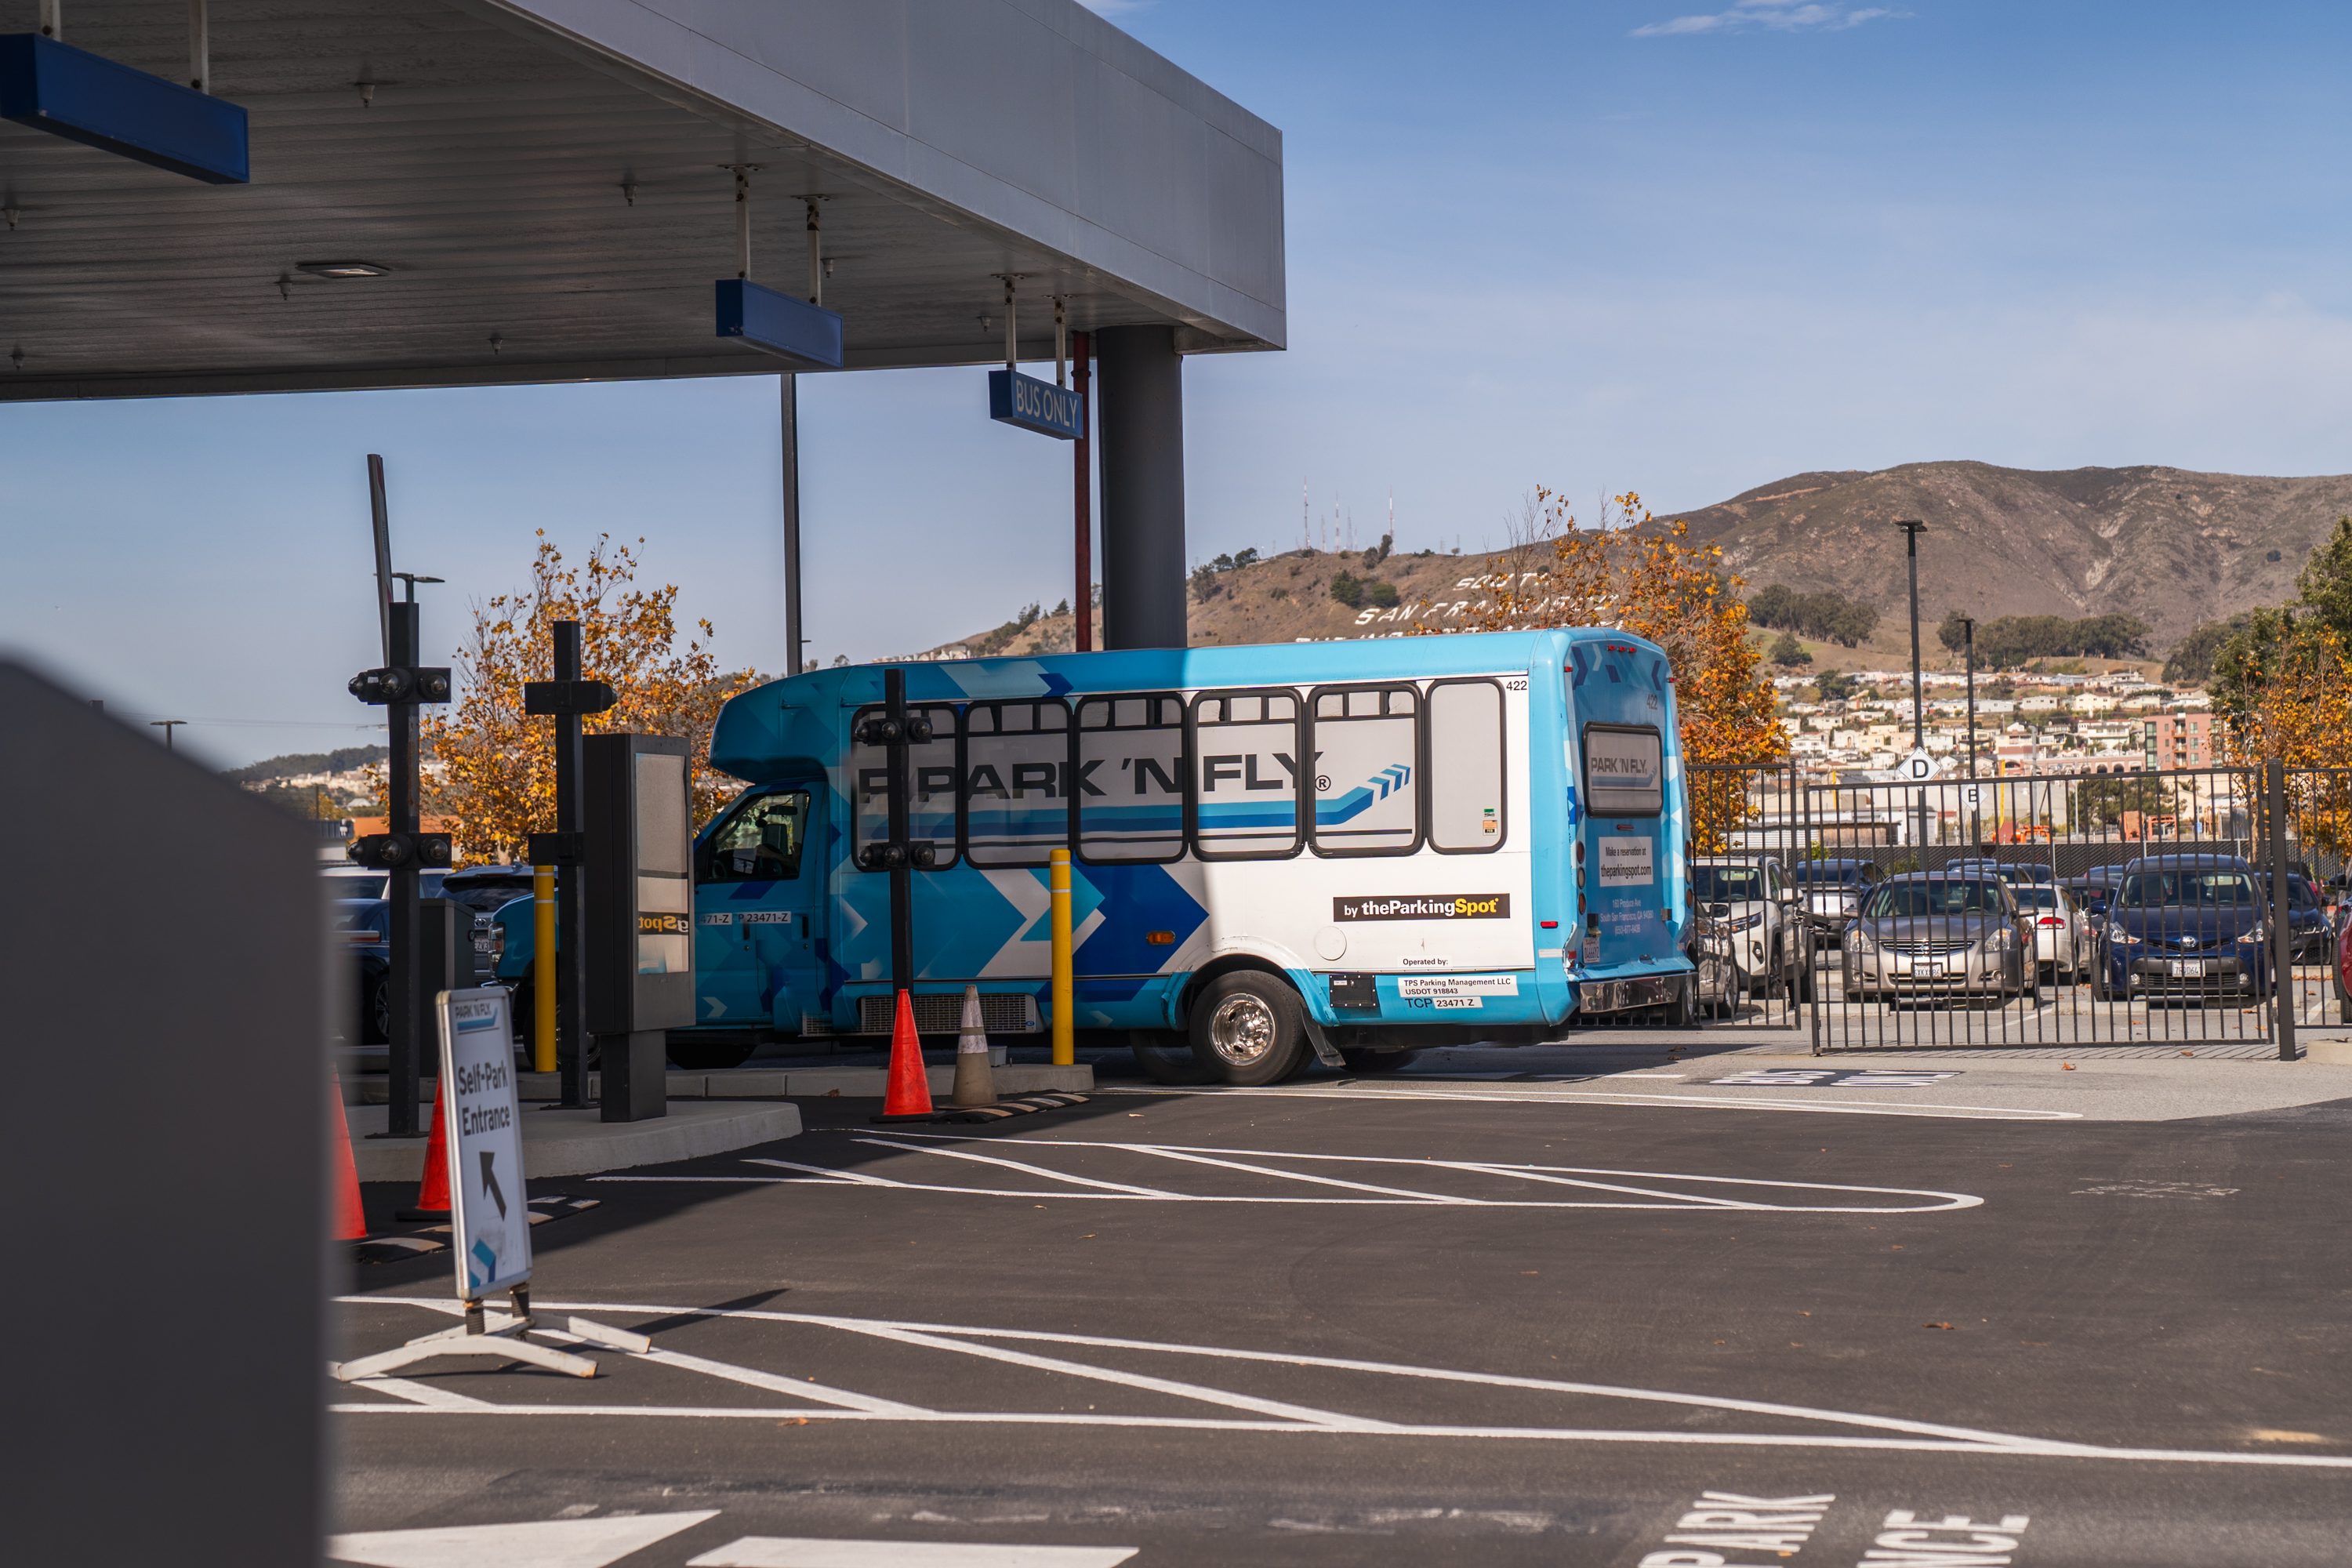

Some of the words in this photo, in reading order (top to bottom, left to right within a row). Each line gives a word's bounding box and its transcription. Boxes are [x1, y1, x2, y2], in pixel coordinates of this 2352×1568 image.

[1016, 379, 1040, 417] BUS
[1044, 390, 1077, 429] ONLY
[1355, 603, 1419, 626] SAN
[1506, 681, 1527, 691] 422
[1647, 694, 1658, 710] 422
[1591, 757, 1618, 773] PARK
[1913, 760, 1929, 778] D
[918, 760, 1107, 803] PARK
[1969, 789, 1977, 802] B
[1606, 847, 1616, 856] Make
[1621, 846, 1641, 856] reservation
[1601, 863, 1651, 880] theparkingspot.com
[1344, 905, 1358, 918] by
[1361, 898, 1499, 917] theParkingSpot
[746, 913, 788, 923] 23471-Z
[1600, 913, 1610, 923] South
[1914, 968, 1940, 977] 6XKX86
[1404, 998, 1432, 1008] TCP
[458, 1059, 509, 1096] Self-Park
[462, 1104, 510, 1137] Entrance
